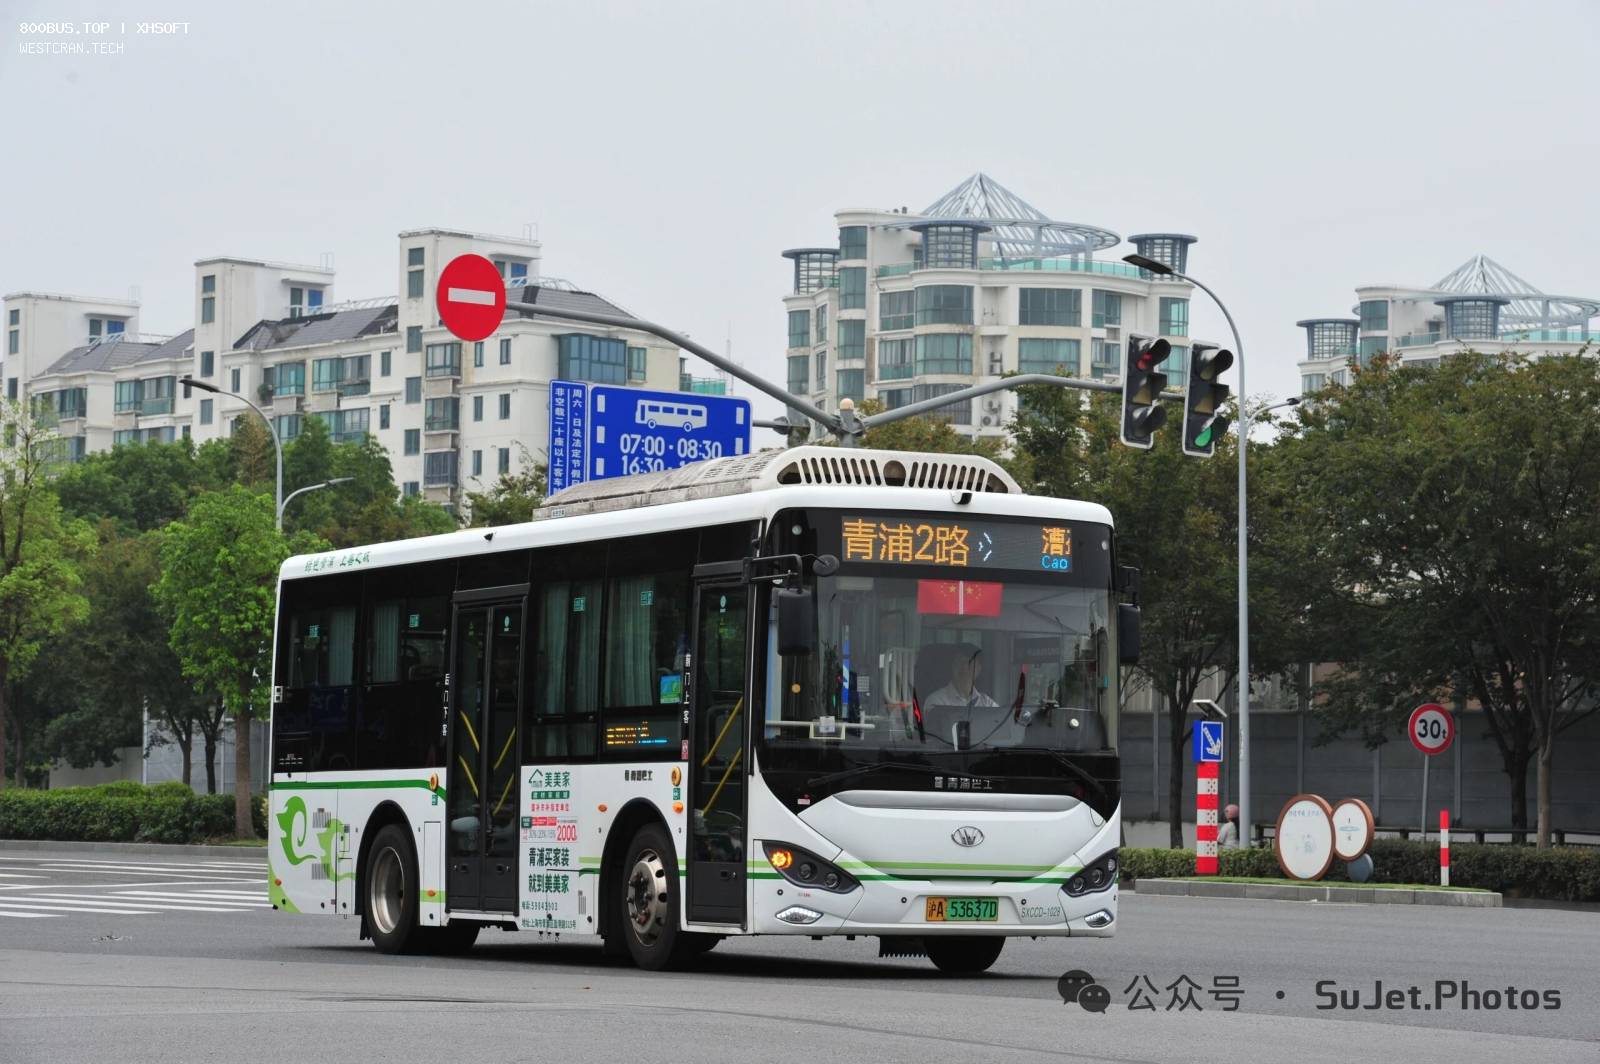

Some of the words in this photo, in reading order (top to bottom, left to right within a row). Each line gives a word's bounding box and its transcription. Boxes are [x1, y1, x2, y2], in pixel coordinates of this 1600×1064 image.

[620, 433, 666, 457] 07:00
[677, 438, 722, 460] 08:30
[843, 518, 970, 566] 青浦2路
[1041, 556, 1069, 570] Cao
[545, 771, 571, 788] 美美家
[529, 847, 570, 867] 青浦买家装
[529, 874, 570, 894] 就到美美家
[950, 900, 997, 919] 53637D
